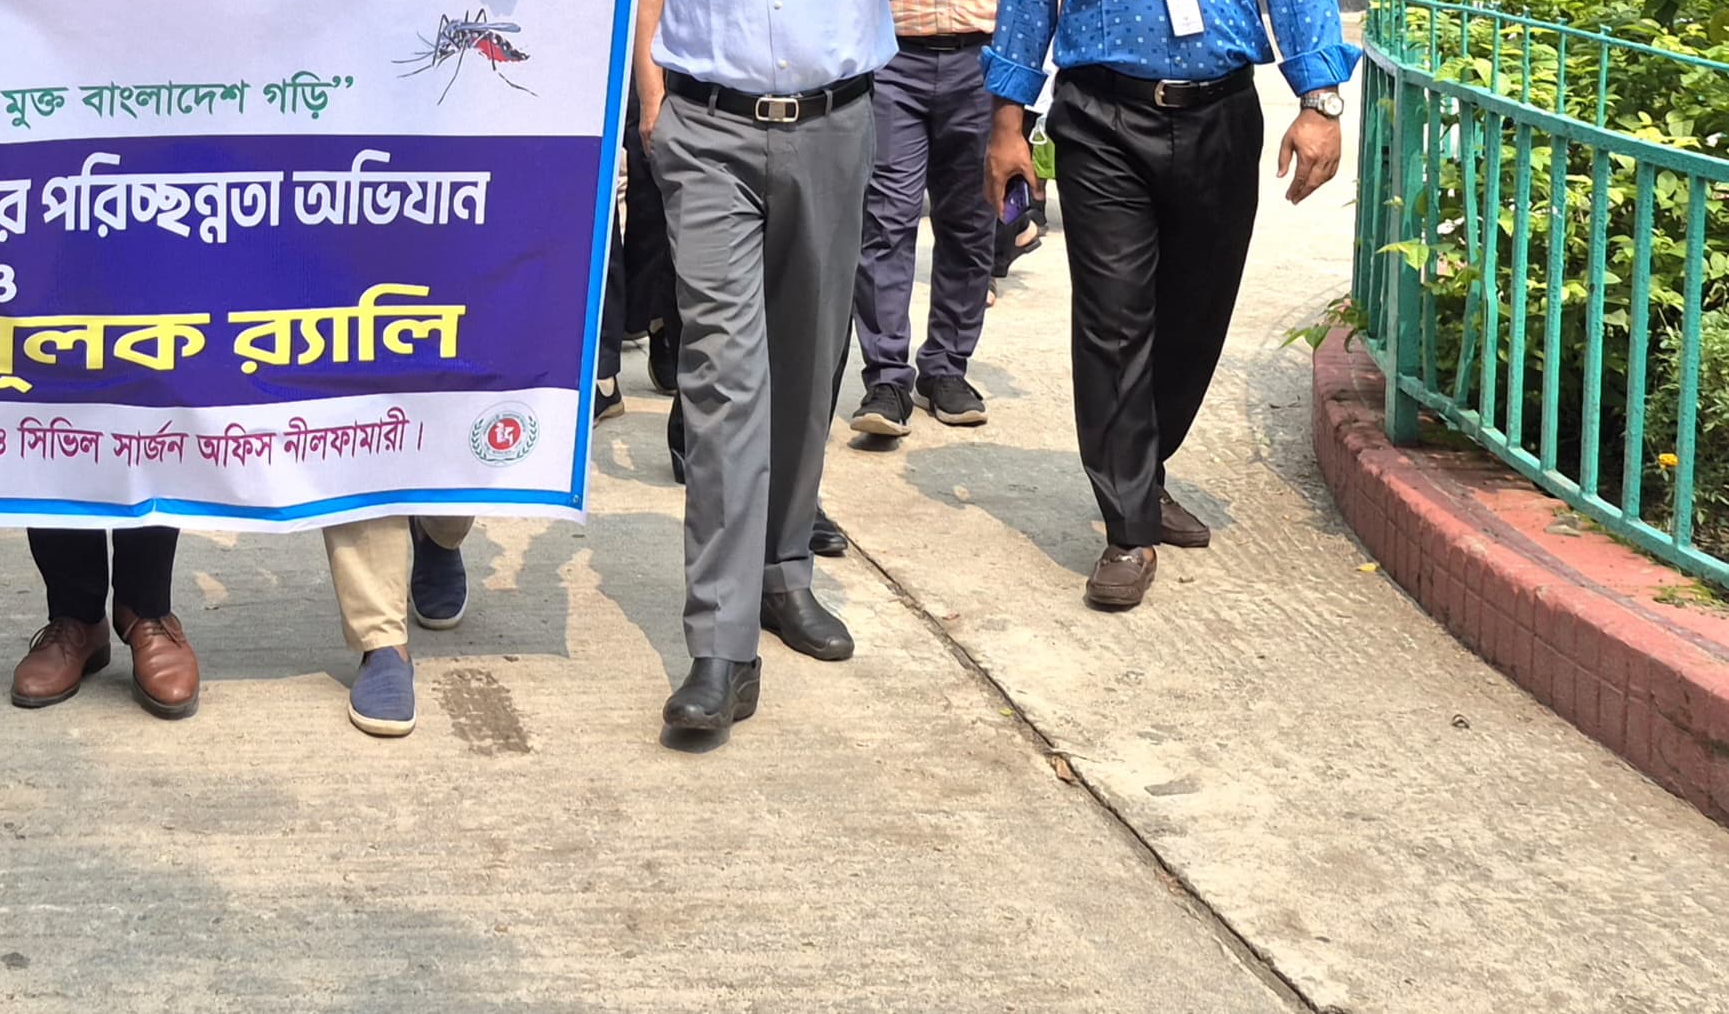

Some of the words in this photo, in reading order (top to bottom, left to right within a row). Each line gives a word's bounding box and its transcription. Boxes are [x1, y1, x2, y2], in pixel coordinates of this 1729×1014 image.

[1, 85, 69, 128] মুক্ত
[78, 79, 249, 120] বাংলাদেশ
[41, 150, 283, 245] পরিচ্ছন্নতা
[292, 148, 492, 227] অভিযান
[16, 416, 104, 465] সিভিল
[110, 419, 190, 468] সার্জন
[195, 421, 278, 468] অফিস
[282, 406, 411, 464] নীলফামারী
